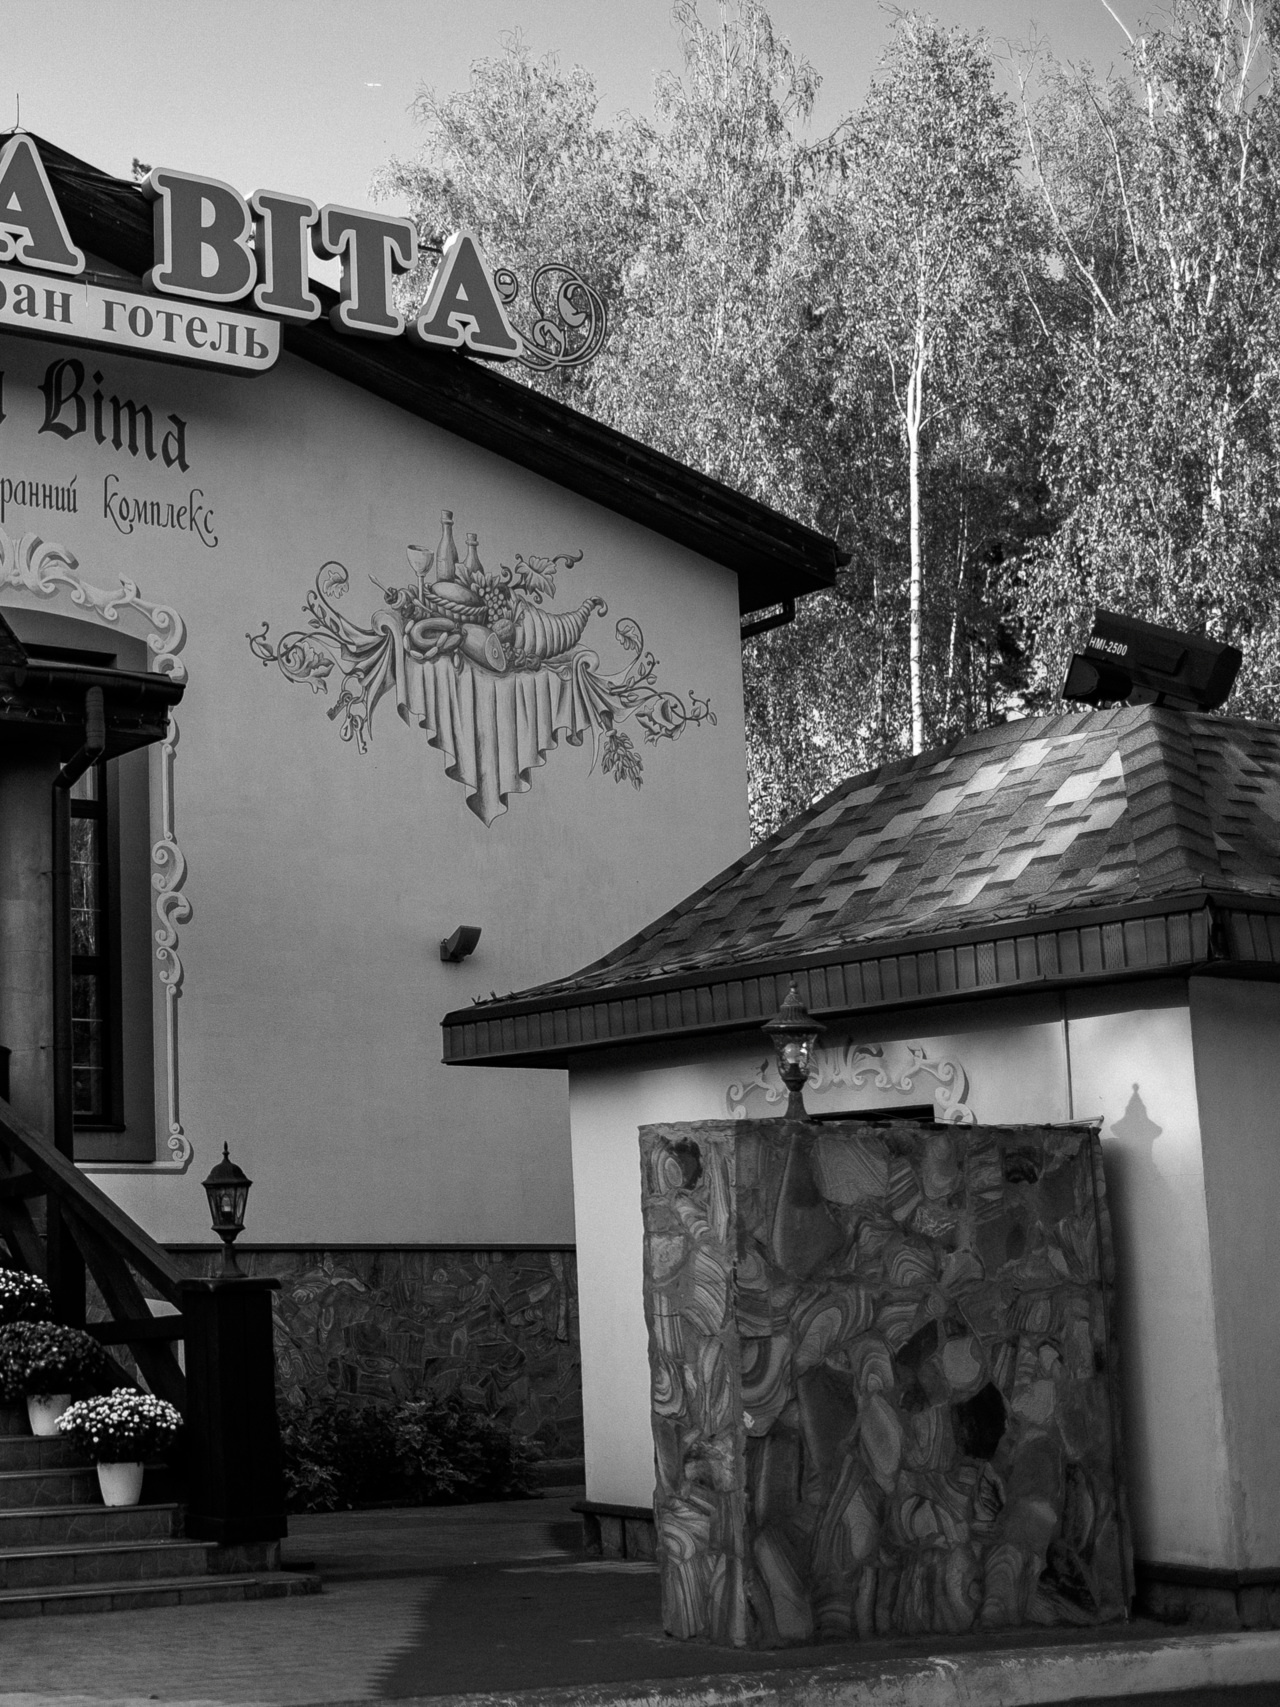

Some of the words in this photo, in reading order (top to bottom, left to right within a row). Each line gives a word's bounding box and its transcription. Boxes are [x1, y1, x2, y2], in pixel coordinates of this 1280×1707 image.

[142, 167, 524, 359] ВІТА
[102, 297, 271, 361] готель
[37, 358, 191, 474] Віта
[1088, 636, 1128, 656] HMI-2500
